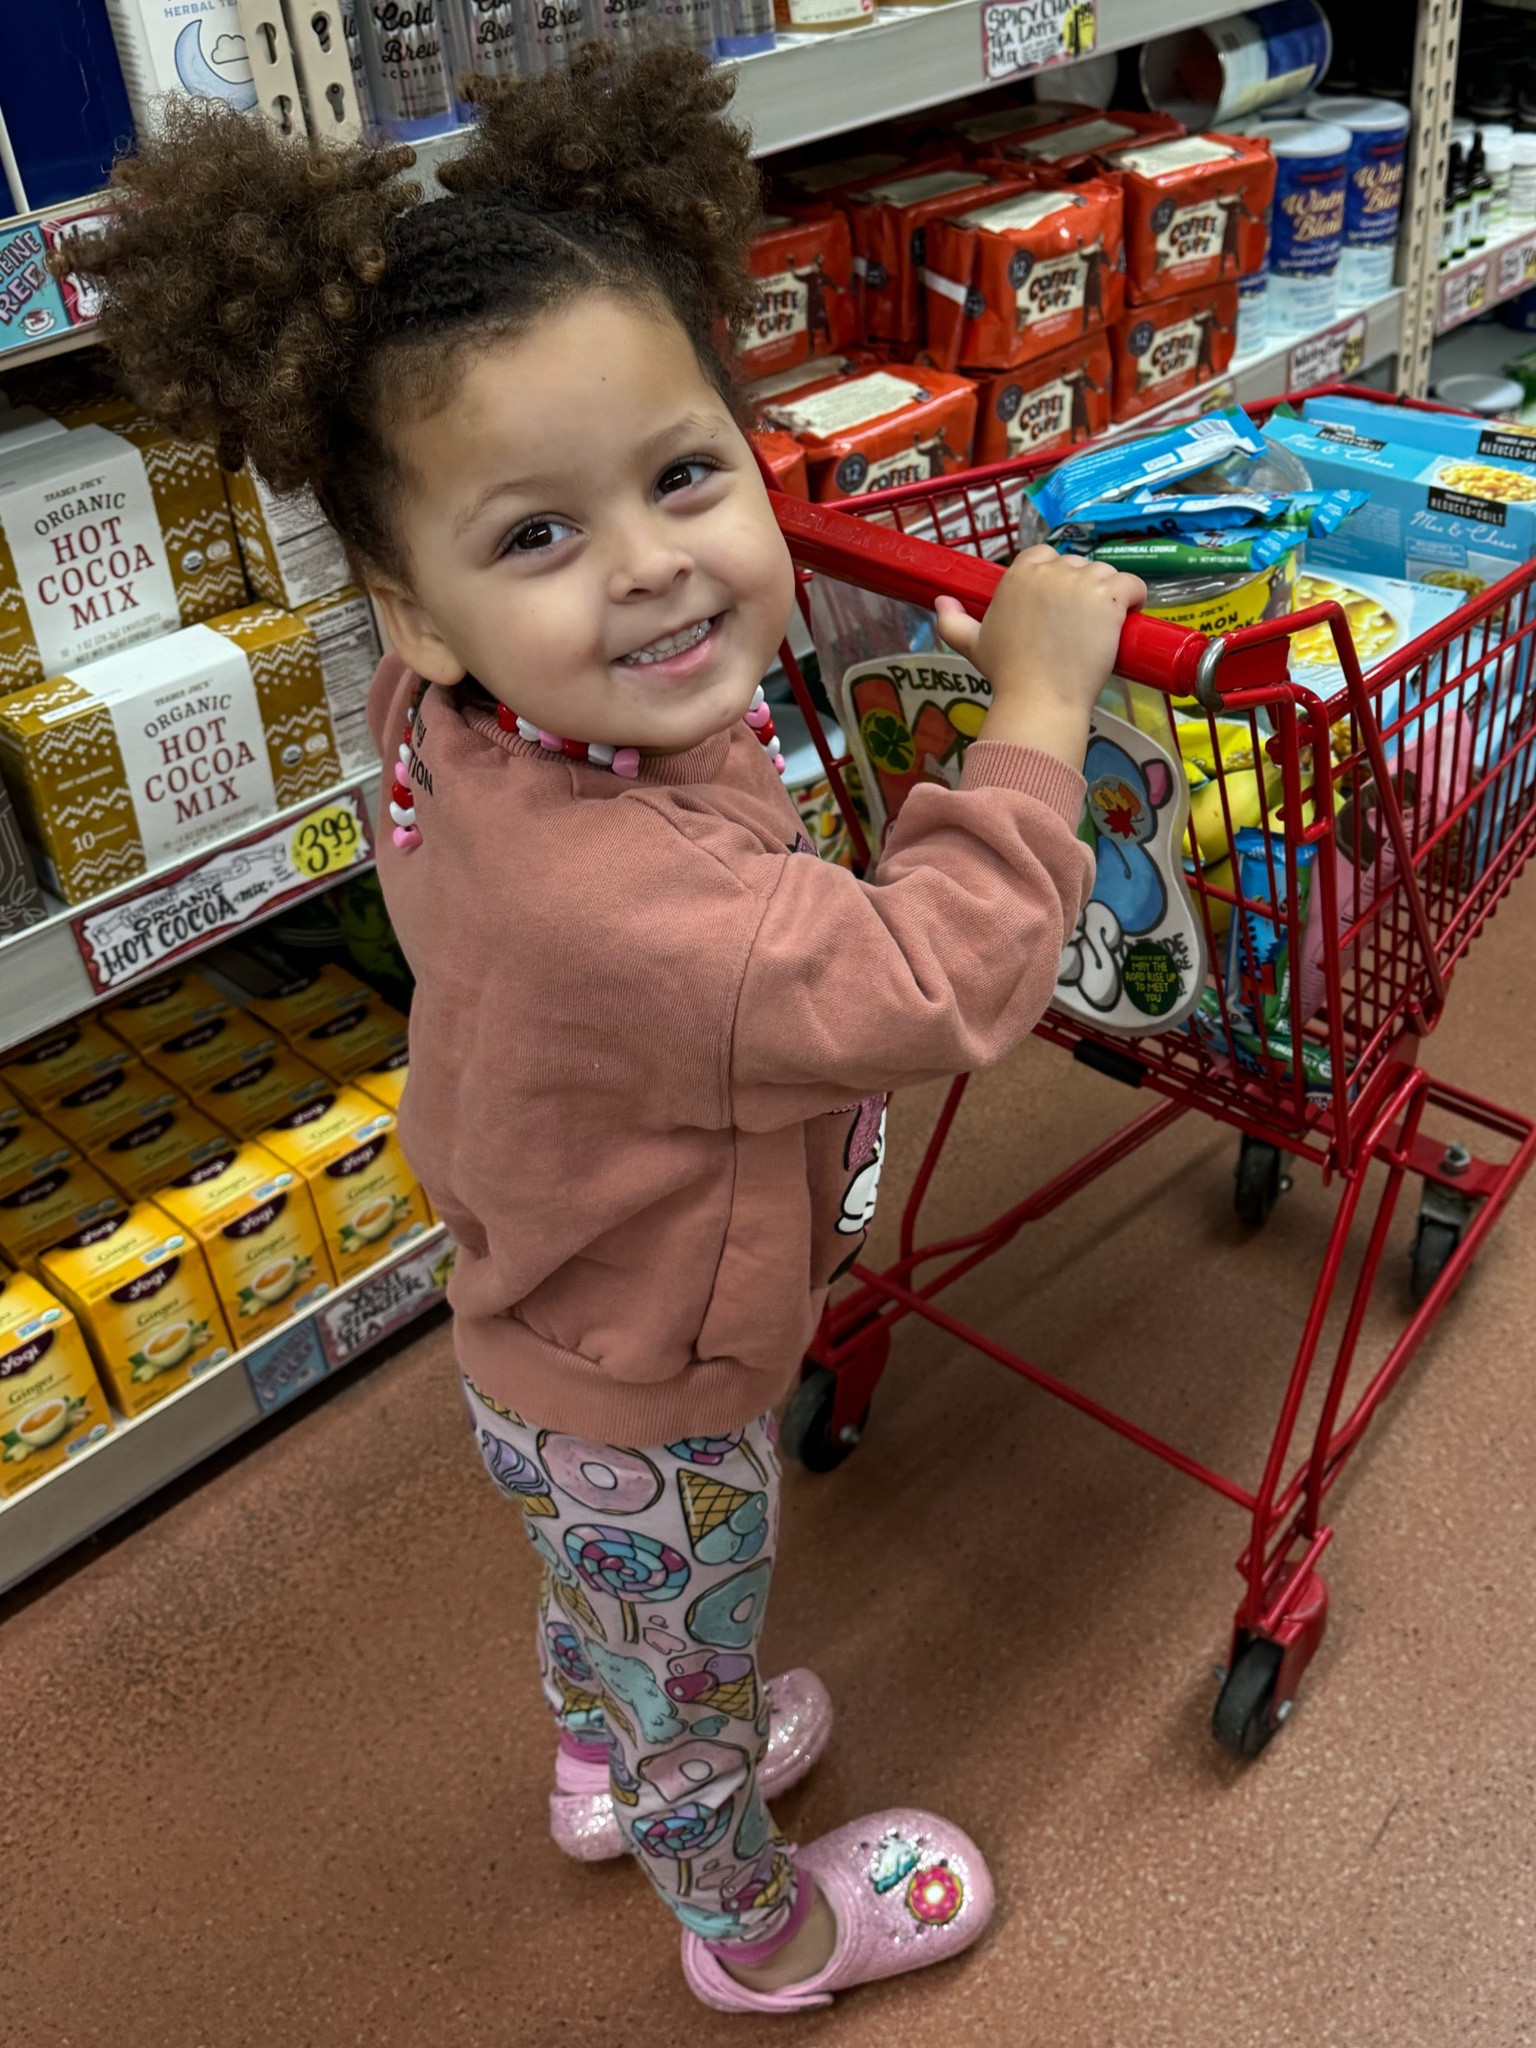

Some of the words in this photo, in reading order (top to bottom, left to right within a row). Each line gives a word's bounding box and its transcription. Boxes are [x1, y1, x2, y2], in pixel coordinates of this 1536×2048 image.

[164, 1, 216, 18] HERBAL
[374, 0, 434, 31] Cold
[988, 3, 1038, 32] SPICY
[381, 39, 441, 63] Brew
[1169, 215, 1218, 248] COFFEE
[1029, 268, 1078, 302] COFFEE
[1152, 334, 1194, 367] COFFEE
[1019, 394, 1064, 431] COFFEE
[845, 466, 861, 482] 12
[34, 493, 126, 536] ORGANIC
[50, 516, 123, 566] HOT
[1410, 511, 1444, 533] Mac
[1449, 521, 1463, 537] &
[1465, 523, 1518, 550] Cheese
[37, 543, 156, 606] COCOA
[69, 581, 140, 630] MIX
[1200, 611, 1239, 633] MON
[887, 665, 966, 693] PLEASE
[965, 674, 992, 696] DO
[144, 694, 232, 739] ORGANIC
[159, 716, 228, 765] HOT
[144, 740, 256, 803] COCOA
[174, 776, 240, 825] MIX
[71, 831, 96, 854] 10
[133, 881, 224, 931] ORGANIC
[100, 931, 155, 984] HOT
[158, 895, 238, 948] COCOA
[1152, 961, 1169, 972] THE
[1166, 972, 1178, 984] UP
[1135, 982, 1146, 992] TO
[1147, 983, 1169, 993] MEET
[1144, 992, 1163, 1003] YOU
[342, 1147, 375, 1174] yogi
[79, 1218, 118, 1247] yogi
[238, 1208, 275, 1237] yogi
[245, 1233, 286, 1262] Ginger
[128, 1268, 167, 1301] yogi
[136, 1297, 180, 1328] Ginger
[0, 1344, 40, 1377] yogi
[8, 1373, 55, 1403] Ginger
